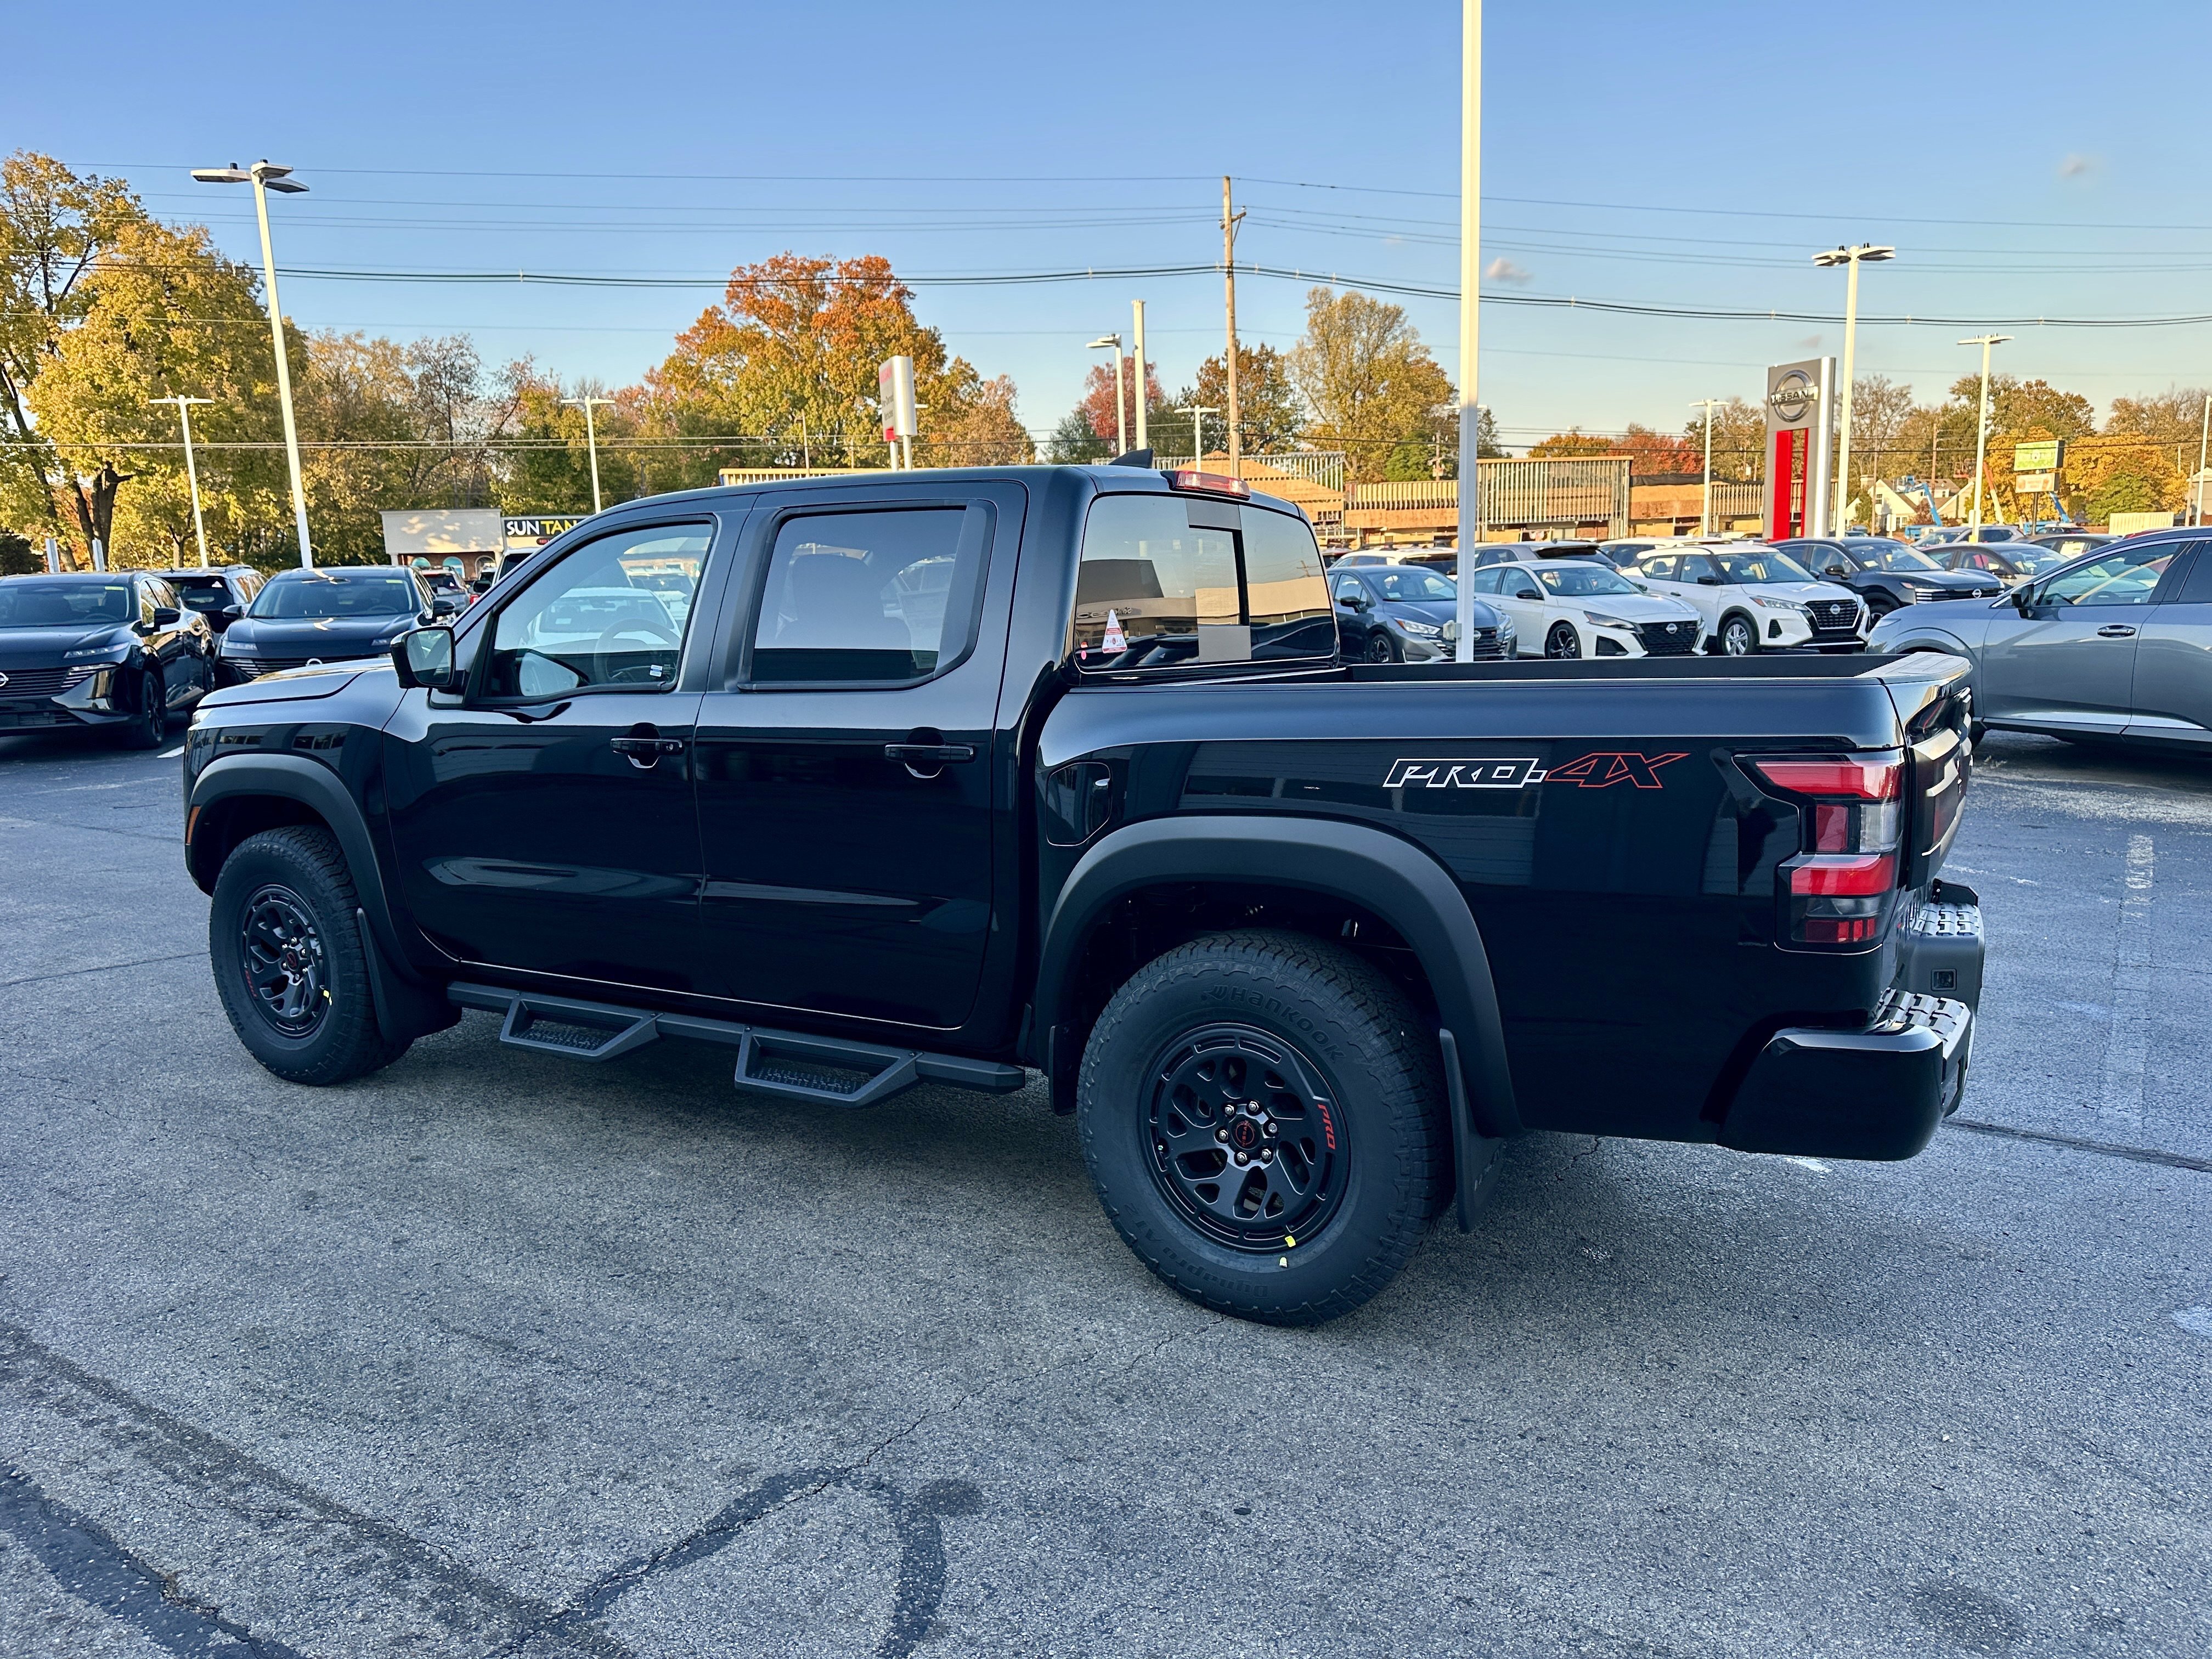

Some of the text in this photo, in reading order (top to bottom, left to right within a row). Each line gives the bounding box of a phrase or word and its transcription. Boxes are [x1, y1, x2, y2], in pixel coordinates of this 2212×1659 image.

[506, 520, 577, 535] SUN TAN
[1318, 1104, 1335, 1150] PRO
